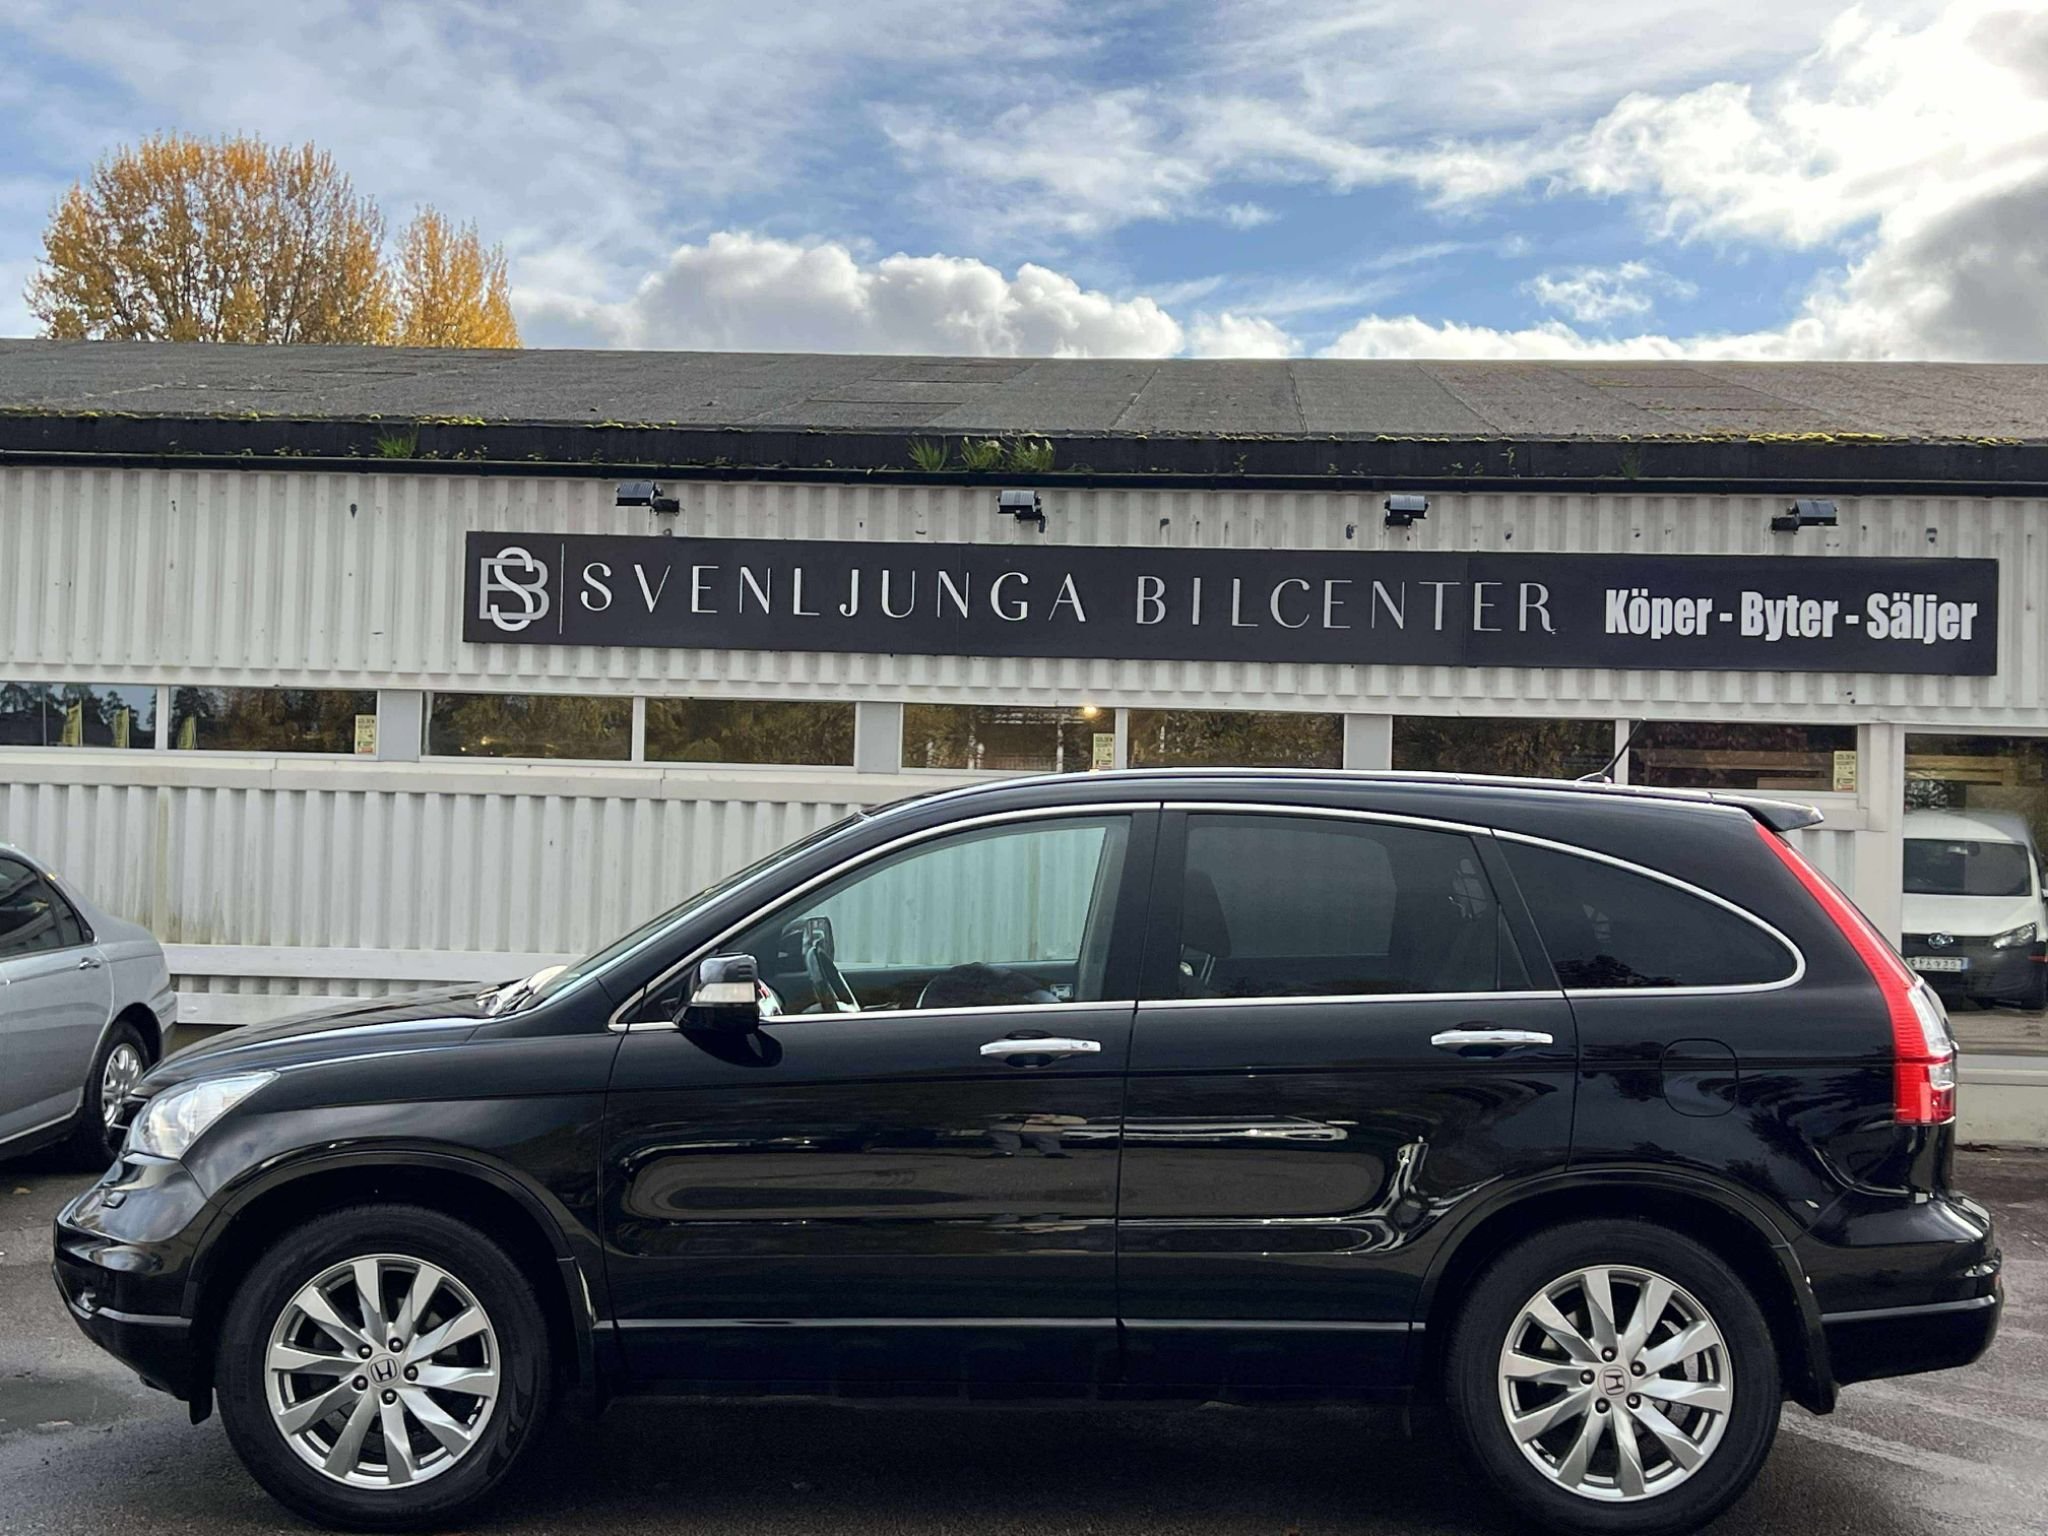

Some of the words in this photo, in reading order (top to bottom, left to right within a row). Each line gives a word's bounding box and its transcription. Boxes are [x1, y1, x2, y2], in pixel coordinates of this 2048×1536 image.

[580, 562, 1087, 622] SVENLJUNGA
[1136, 576, 1558, 634] BILCENTER
[1605, 588, 1713, 640] Köper
[1740, 591, 1839, 642] Byter
[1866, 592, 1978, 645] Säljer
